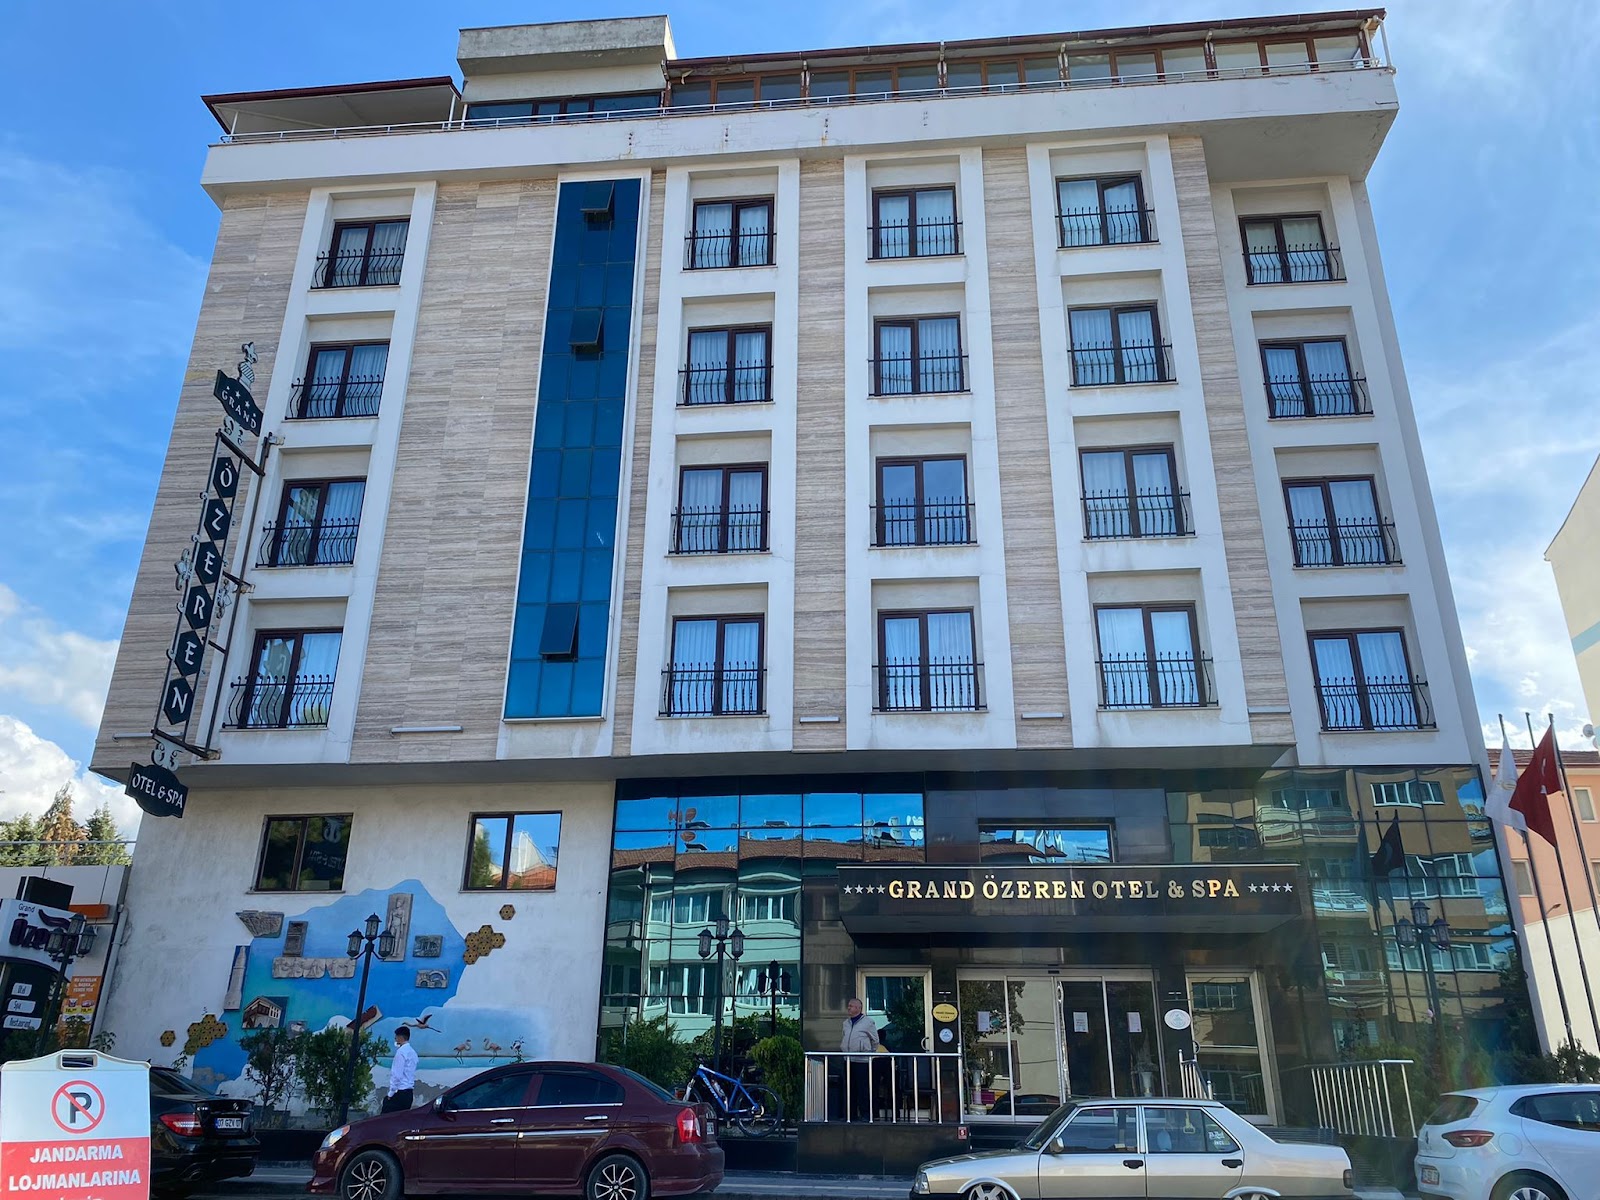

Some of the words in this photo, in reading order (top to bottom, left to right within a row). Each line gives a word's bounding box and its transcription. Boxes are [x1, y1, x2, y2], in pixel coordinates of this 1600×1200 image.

[221, 390, 257, 429] GRAND
[171, 462, 233, 714] ÖZEREN
[132, 773, 156, 797] OTEL
[157, 785, 166, 799] &
[165, 788, 183, 809] SPA
[888, 880, 976, 900] GRAND
[982, 874, 1086, 900] ÖZEREN
[1091, 879, 1160, 900] OTEL
[1167, 879, 1185, 899] &
[1191, 879, 1240, 899] SPA
[18, 902, 36, 913] Grand
[30, 1145, 123, 1163] JANDARMA
[9, 1169, 141, 1191] LOJMANLARINA
